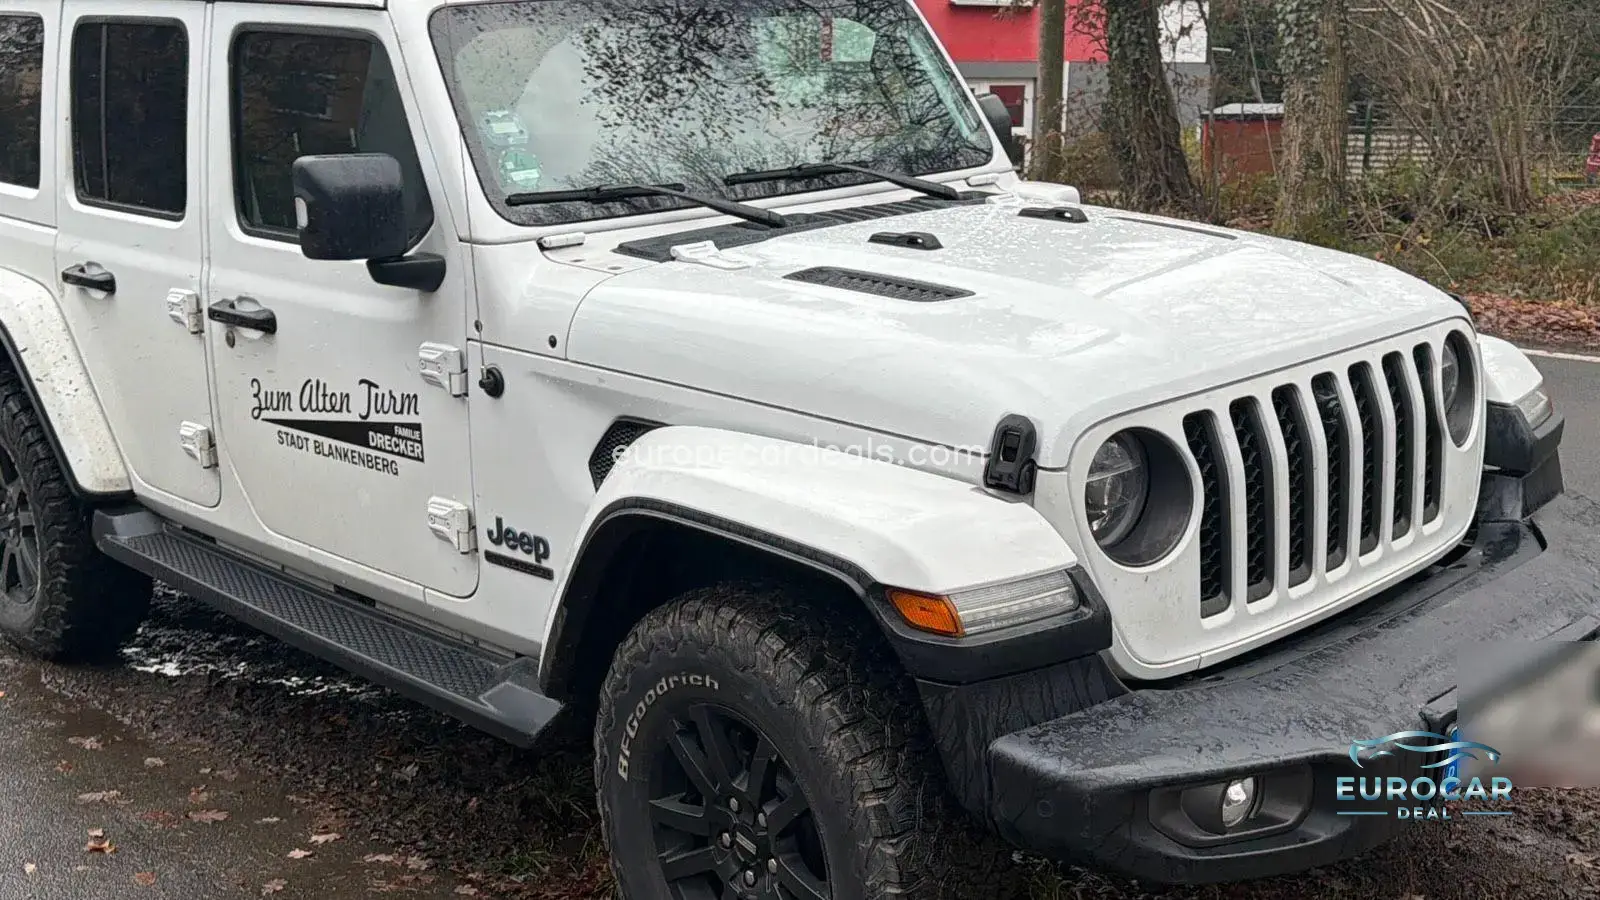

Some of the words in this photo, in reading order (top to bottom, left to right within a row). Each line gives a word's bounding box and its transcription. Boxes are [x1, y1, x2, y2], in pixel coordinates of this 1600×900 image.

[250, 378, 293, 420] Zum
[299, 378, 352, 413] Alten
[358, 378, 420, 420] Turm
[277, 429, 310, 453] STADT
[313, 439, 399, 476] BLANKENBERG
[368, 431, 423, 459] DRECKER
[394, 425, 421, 441] FAMILIE
[487, 515, 550, 564] Jeep
[618, 671, 719, 782] BFGoodrich
